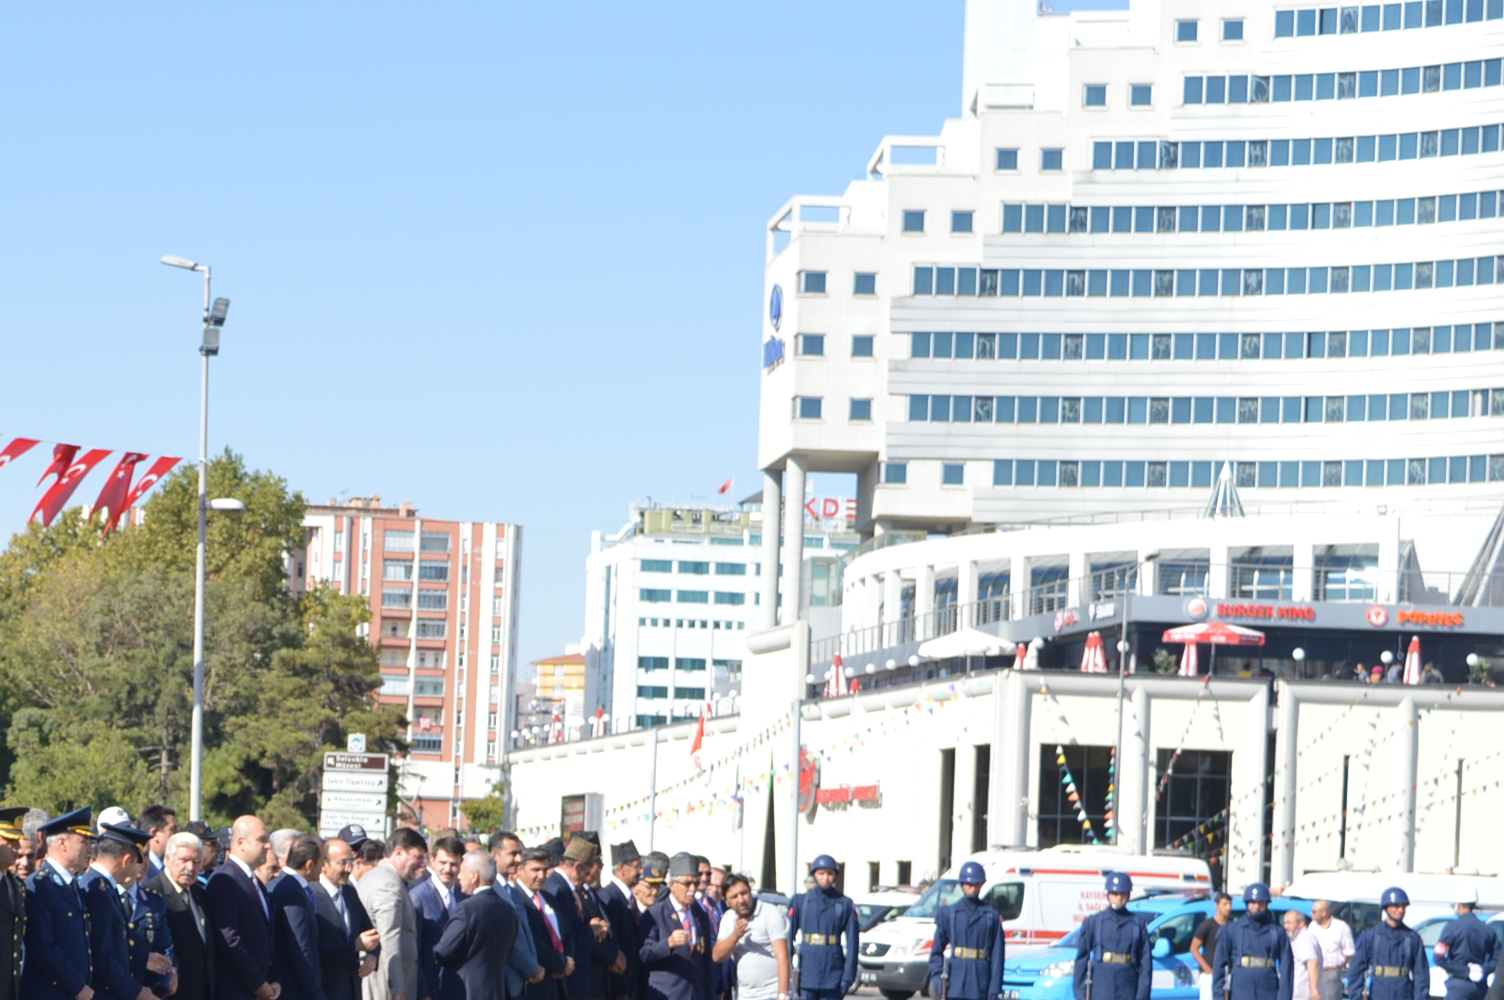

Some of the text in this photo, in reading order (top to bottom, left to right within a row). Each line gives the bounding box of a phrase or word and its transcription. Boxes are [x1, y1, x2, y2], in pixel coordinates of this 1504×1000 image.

[780, 496, 857, 518] KDE
[1217, 603, 1274, 618] BURGER
[1278, 606, 1315, 620] KING
[345, 778, 375, 787] Tiyatrosu
[1080, 891, 1107, 899] KAYSER
